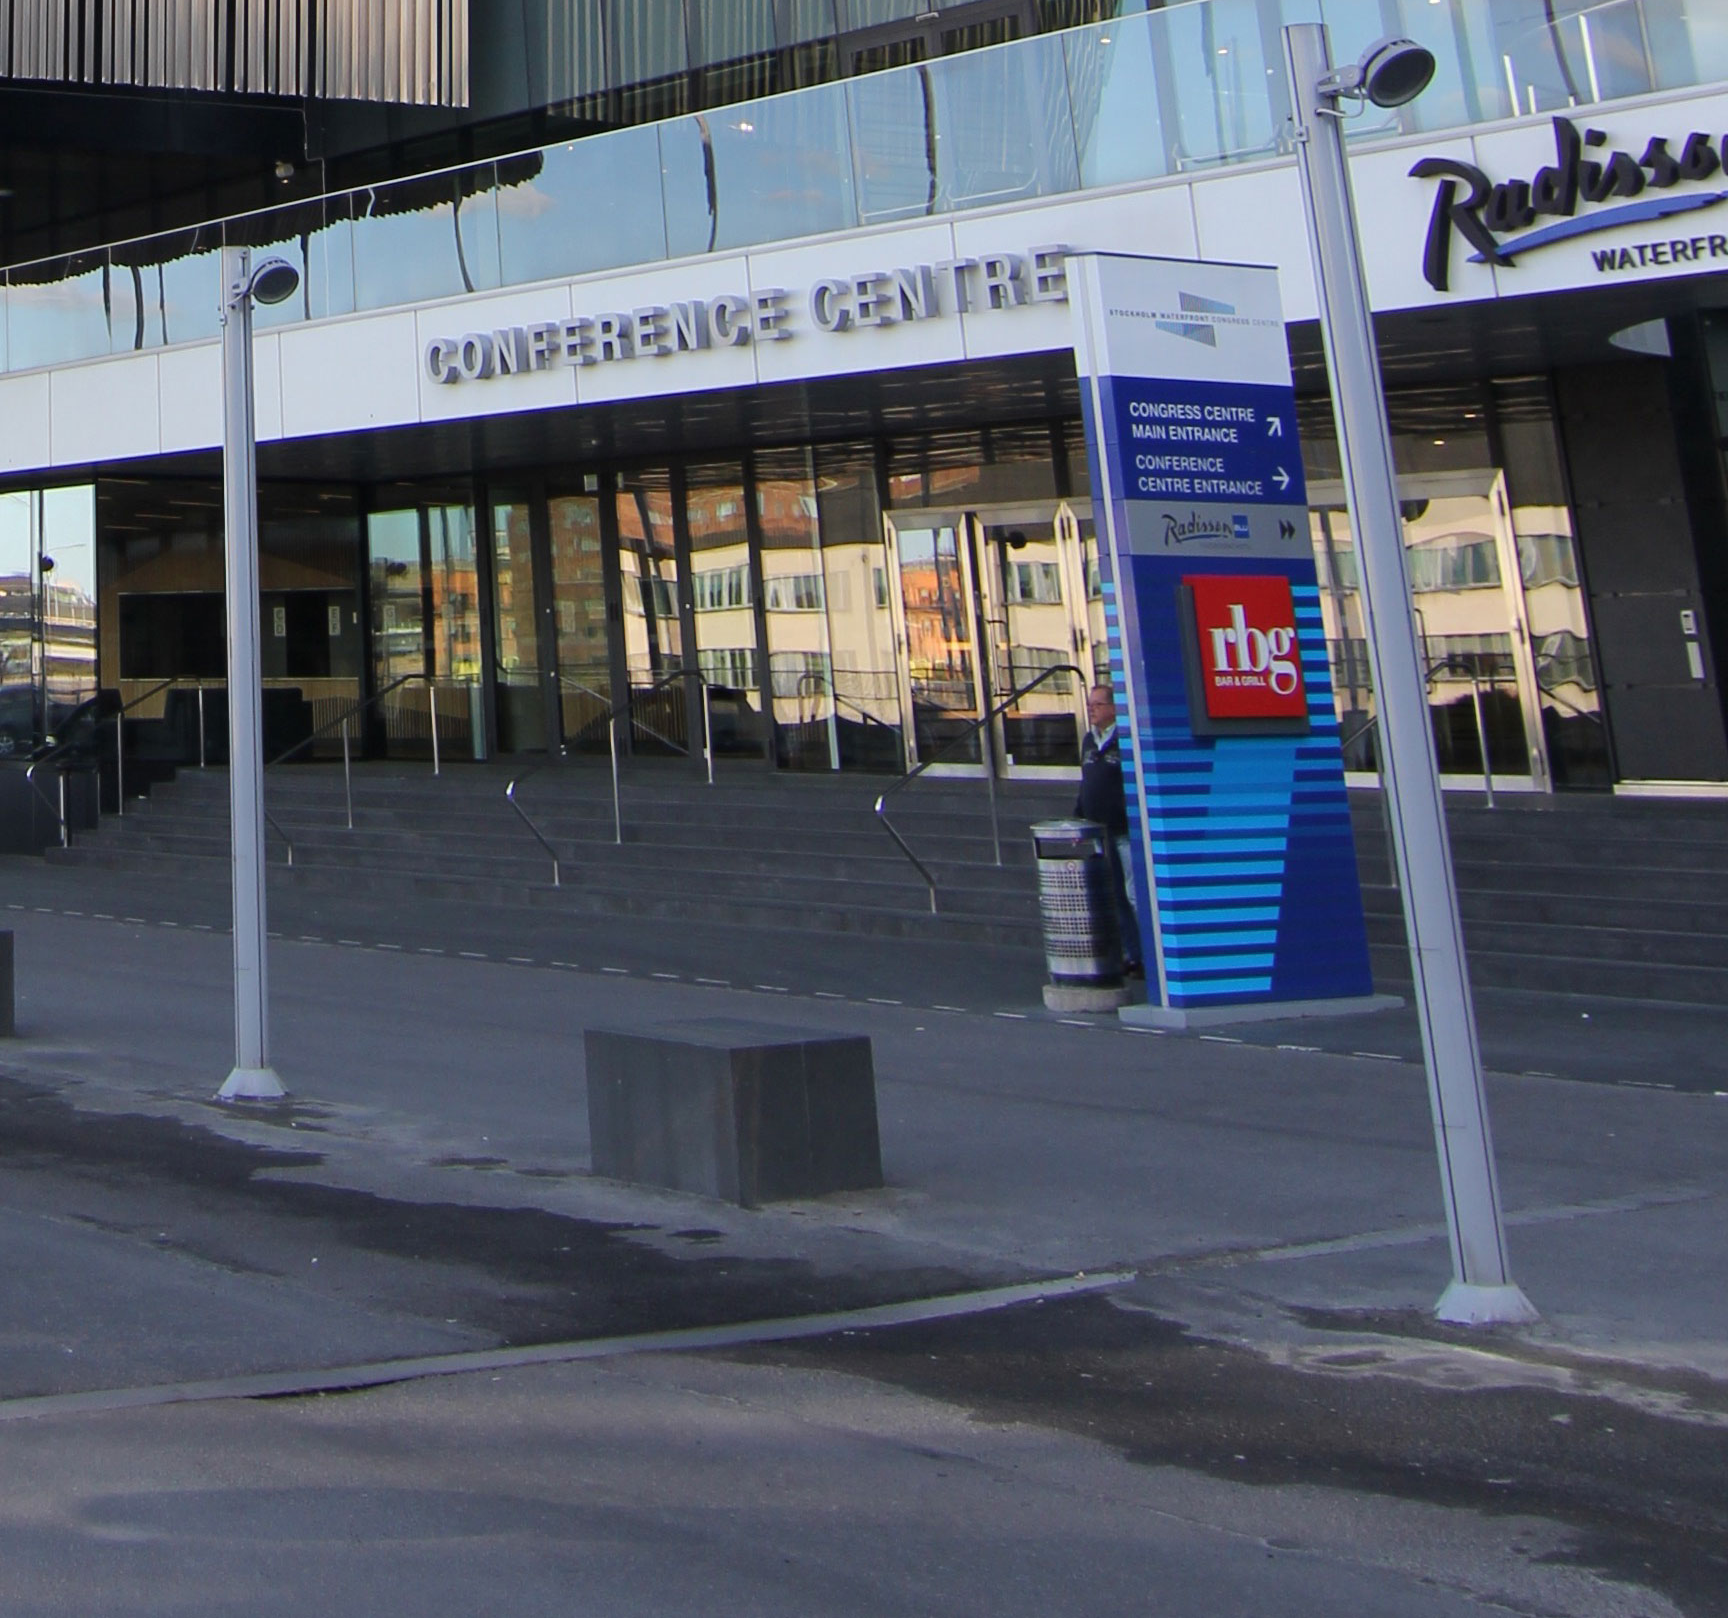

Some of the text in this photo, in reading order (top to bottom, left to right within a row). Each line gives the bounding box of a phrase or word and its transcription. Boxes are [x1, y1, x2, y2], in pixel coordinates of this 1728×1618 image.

[1408, 116, 1728, 292] Radisso
[424, 244, 1070, 384] CONFERENCE CENTRE
[1110, 309, 1279, 327] STOCKHOLM WATERFRONT CONGRESS CENTRE
[1130, 402, 1255, 422] CONGRESS CENTRE
[1132, 424, 1239, 443] MAIN ENTRANCE
[1136, 454, 1225, 472] CONFERENCE
[1138, 477, 1263, 495] CENTRE ENTRANCE
[1161, 510, 1233, 547] Radisson
[1208, 604, 1298, 695] rbg
[1215, 676, 1234, 686] BAR
[1241, 676, 1267, 686] GRILL
